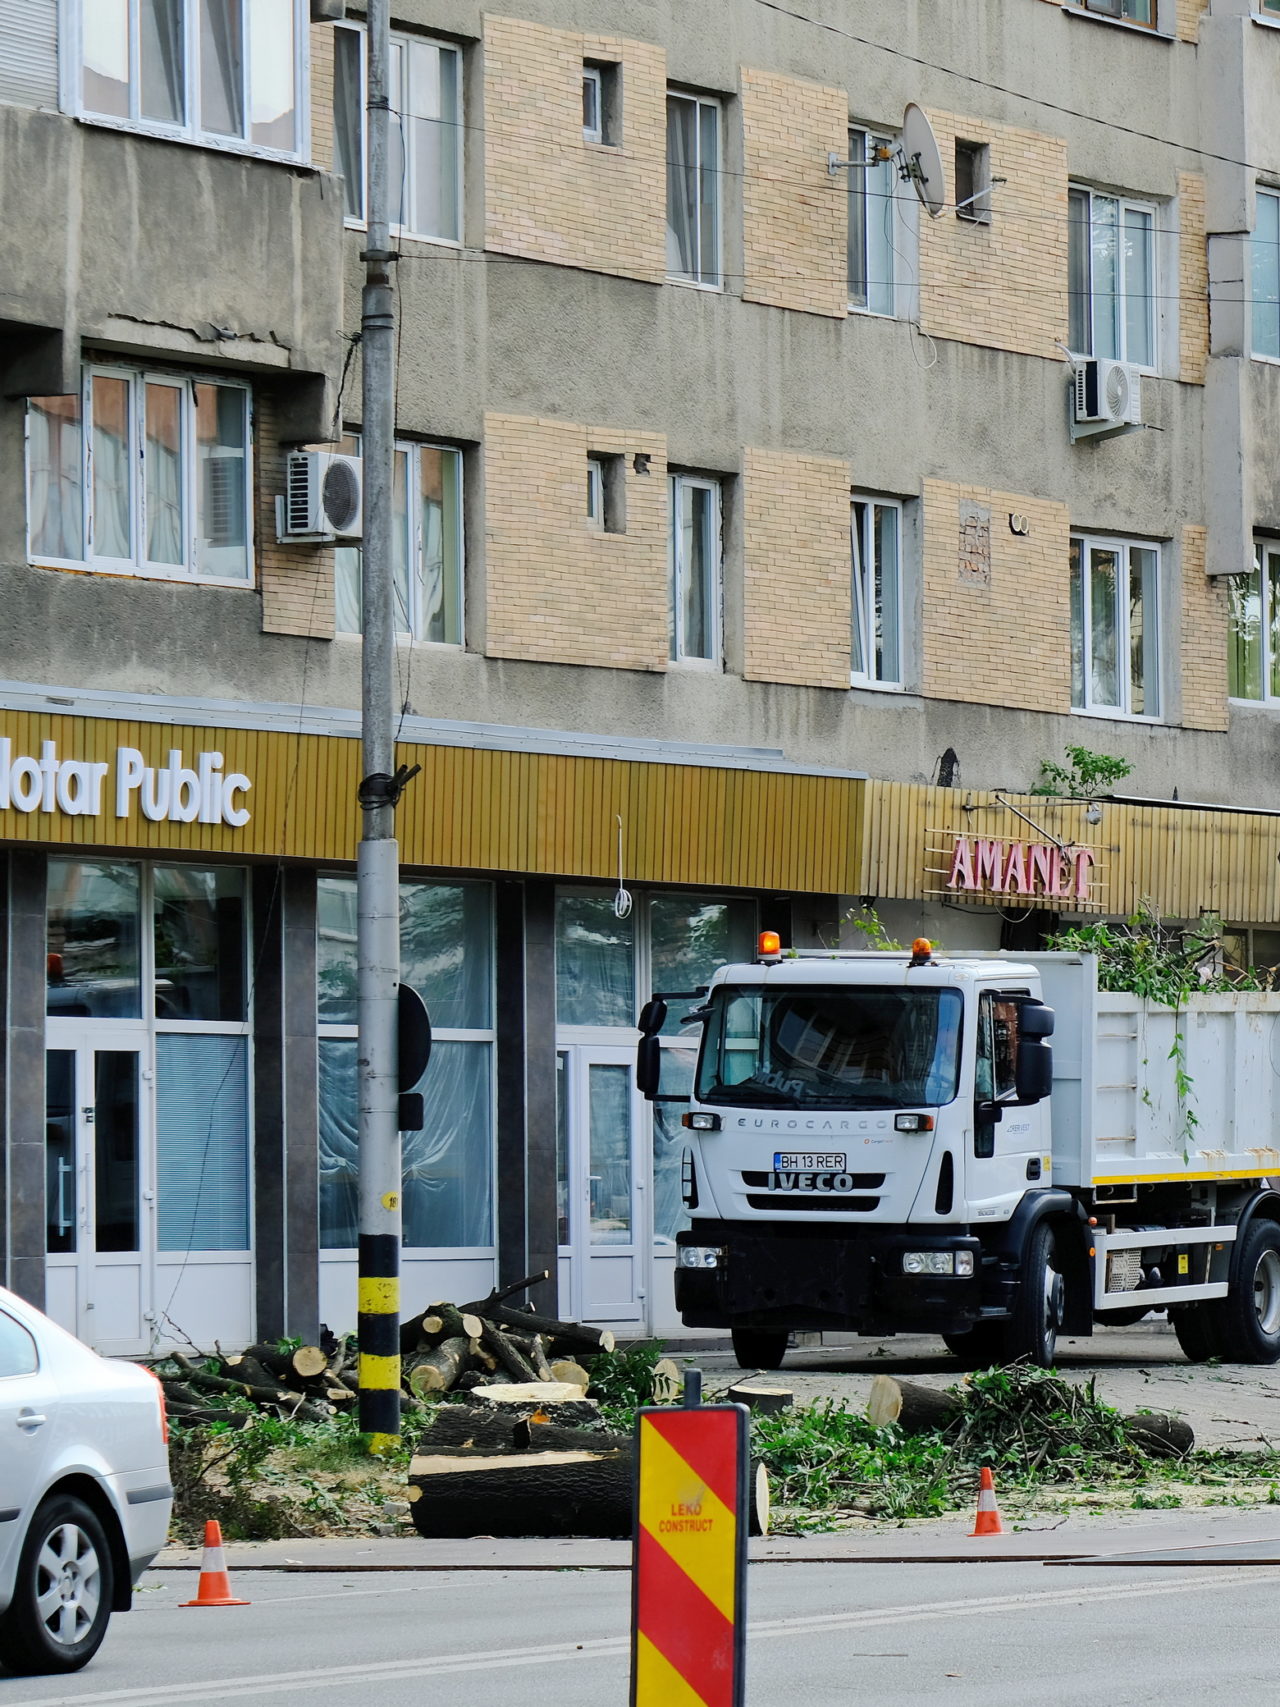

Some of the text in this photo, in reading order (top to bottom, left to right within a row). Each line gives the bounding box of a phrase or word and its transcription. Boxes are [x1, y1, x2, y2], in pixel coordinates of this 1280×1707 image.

[116, 747, 252, 827] Public
[946, 837, 1095, 898] AMANET
[737, 1118, 888, 1129] EUROCARGO
[781, 1155, 843, 1169] BH 13 RER
[768, 1173, 854, 1192] IVECO
[671, 1504, 703, 1516] LEKO
[658, 1519, 713, 1533] CONSTRUCT
